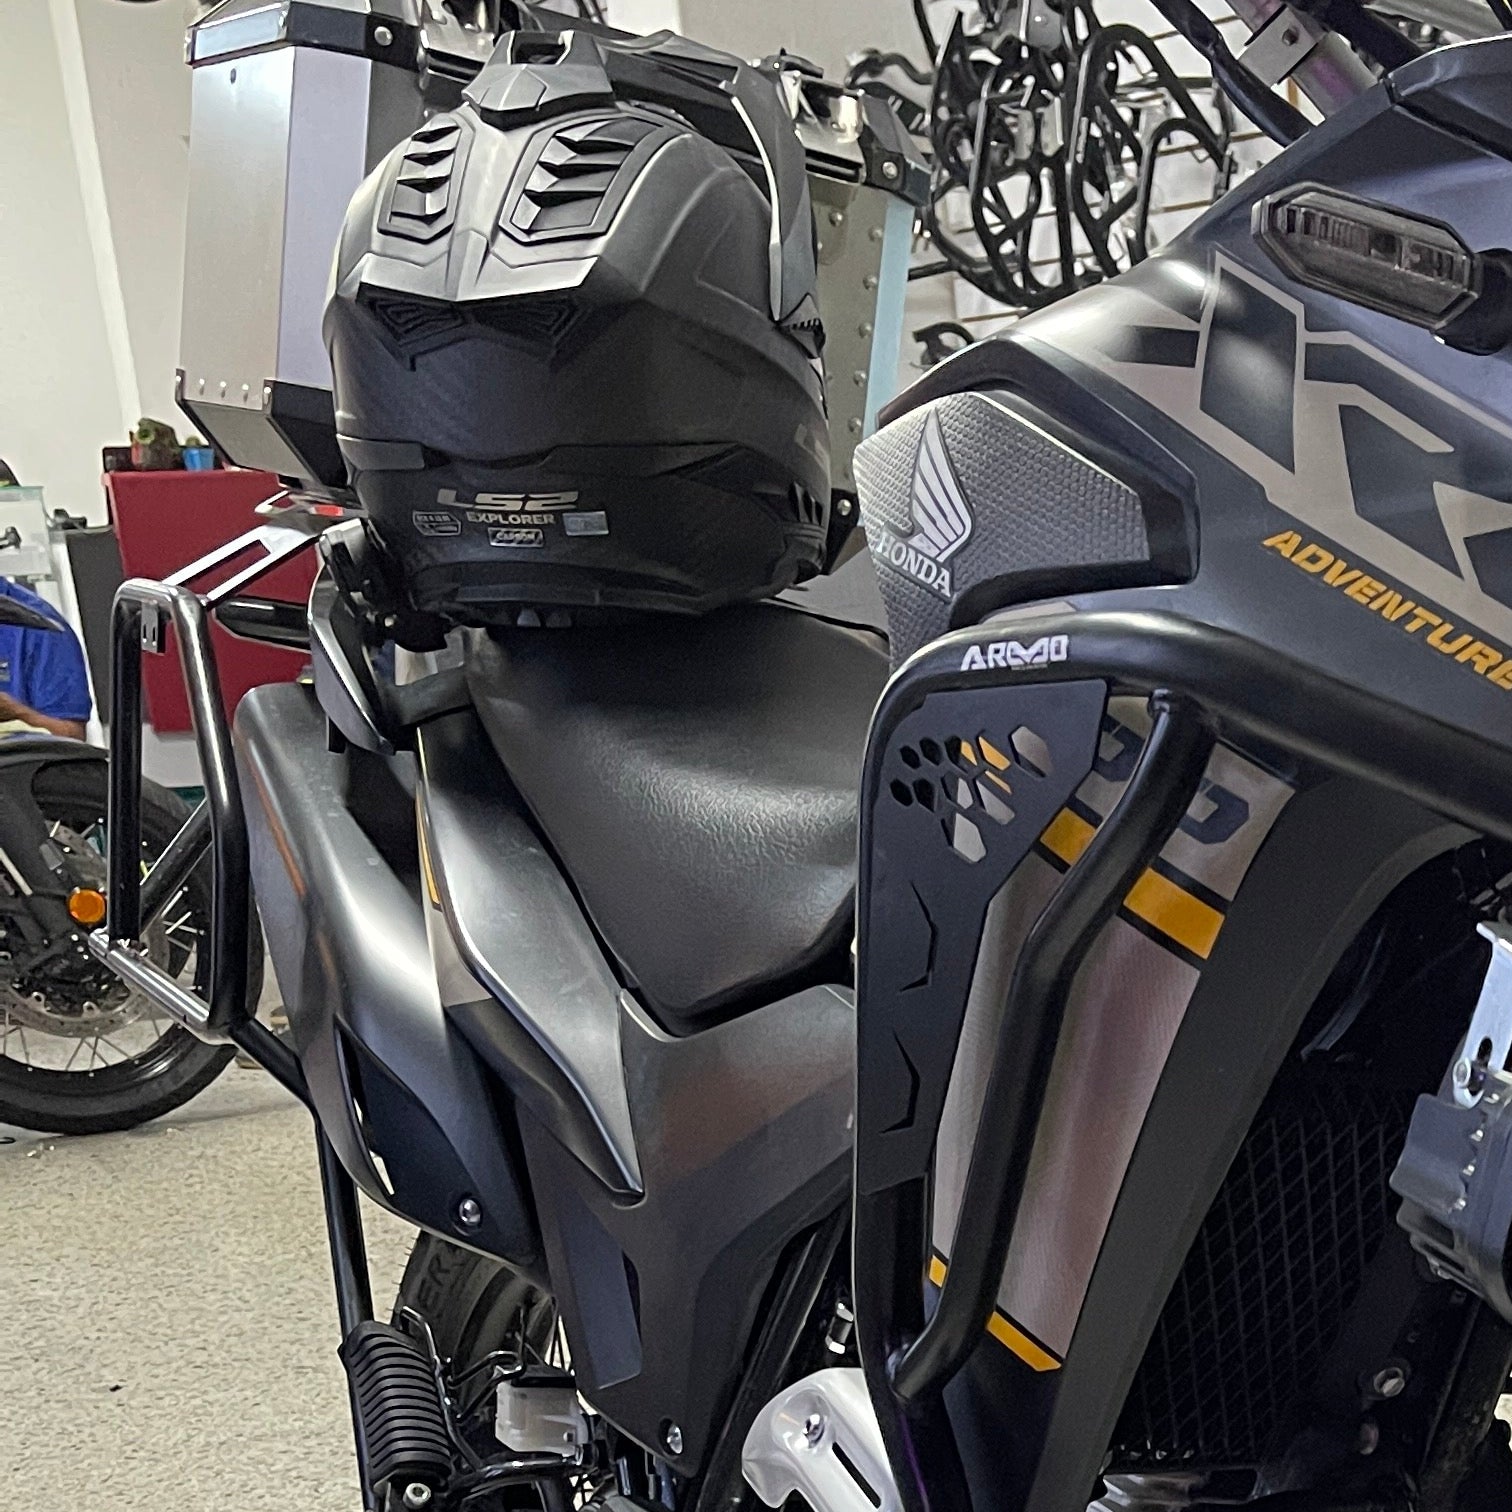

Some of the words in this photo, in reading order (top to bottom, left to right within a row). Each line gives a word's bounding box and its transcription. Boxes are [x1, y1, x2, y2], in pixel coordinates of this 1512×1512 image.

[437, 488, 579, 511] LS2
[466, 511, 555, 524] EXPLORER
[876, 534, 951, 598] HONDA
